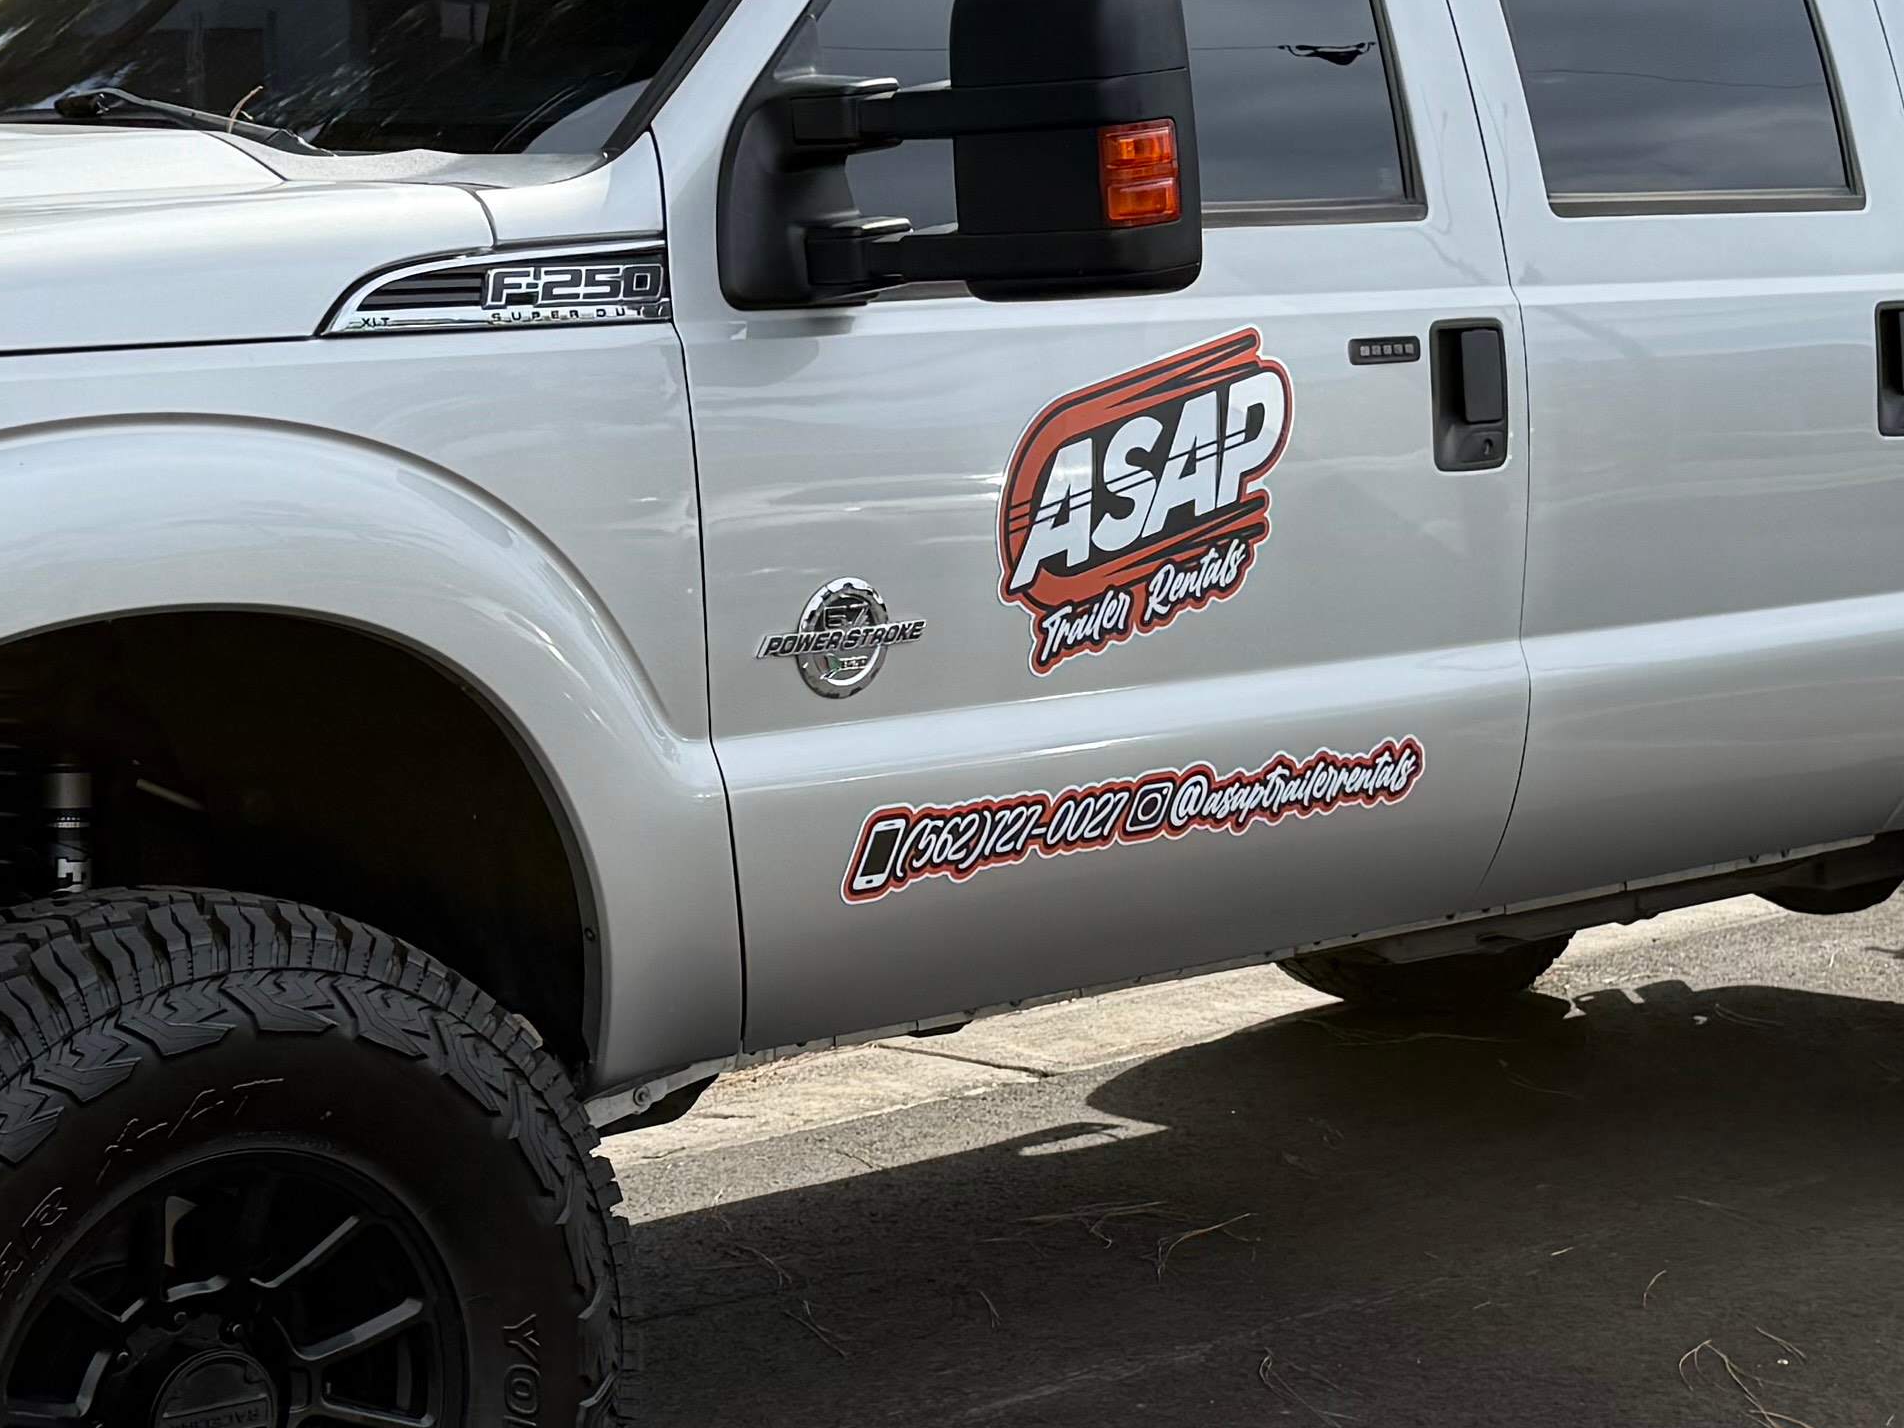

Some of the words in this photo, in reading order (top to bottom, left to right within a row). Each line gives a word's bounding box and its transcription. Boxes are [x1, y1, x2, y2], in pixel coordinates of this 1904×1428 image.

[487, 264, 664, 308] F-250
[360, 316, 390, 328] XLT
[491, 308, 580, 322] SUPER
[1009, 370, 1285, 590] ASAP
[1041, 588, 1132, 662] Trailer
[1143, 537, 1247, 622] Rentals
[762, 632, 842, 658] POWER
[842, 620, 927, 650] STROKE
[1169, 748, 1416, 827] @asaptrailerrentals
